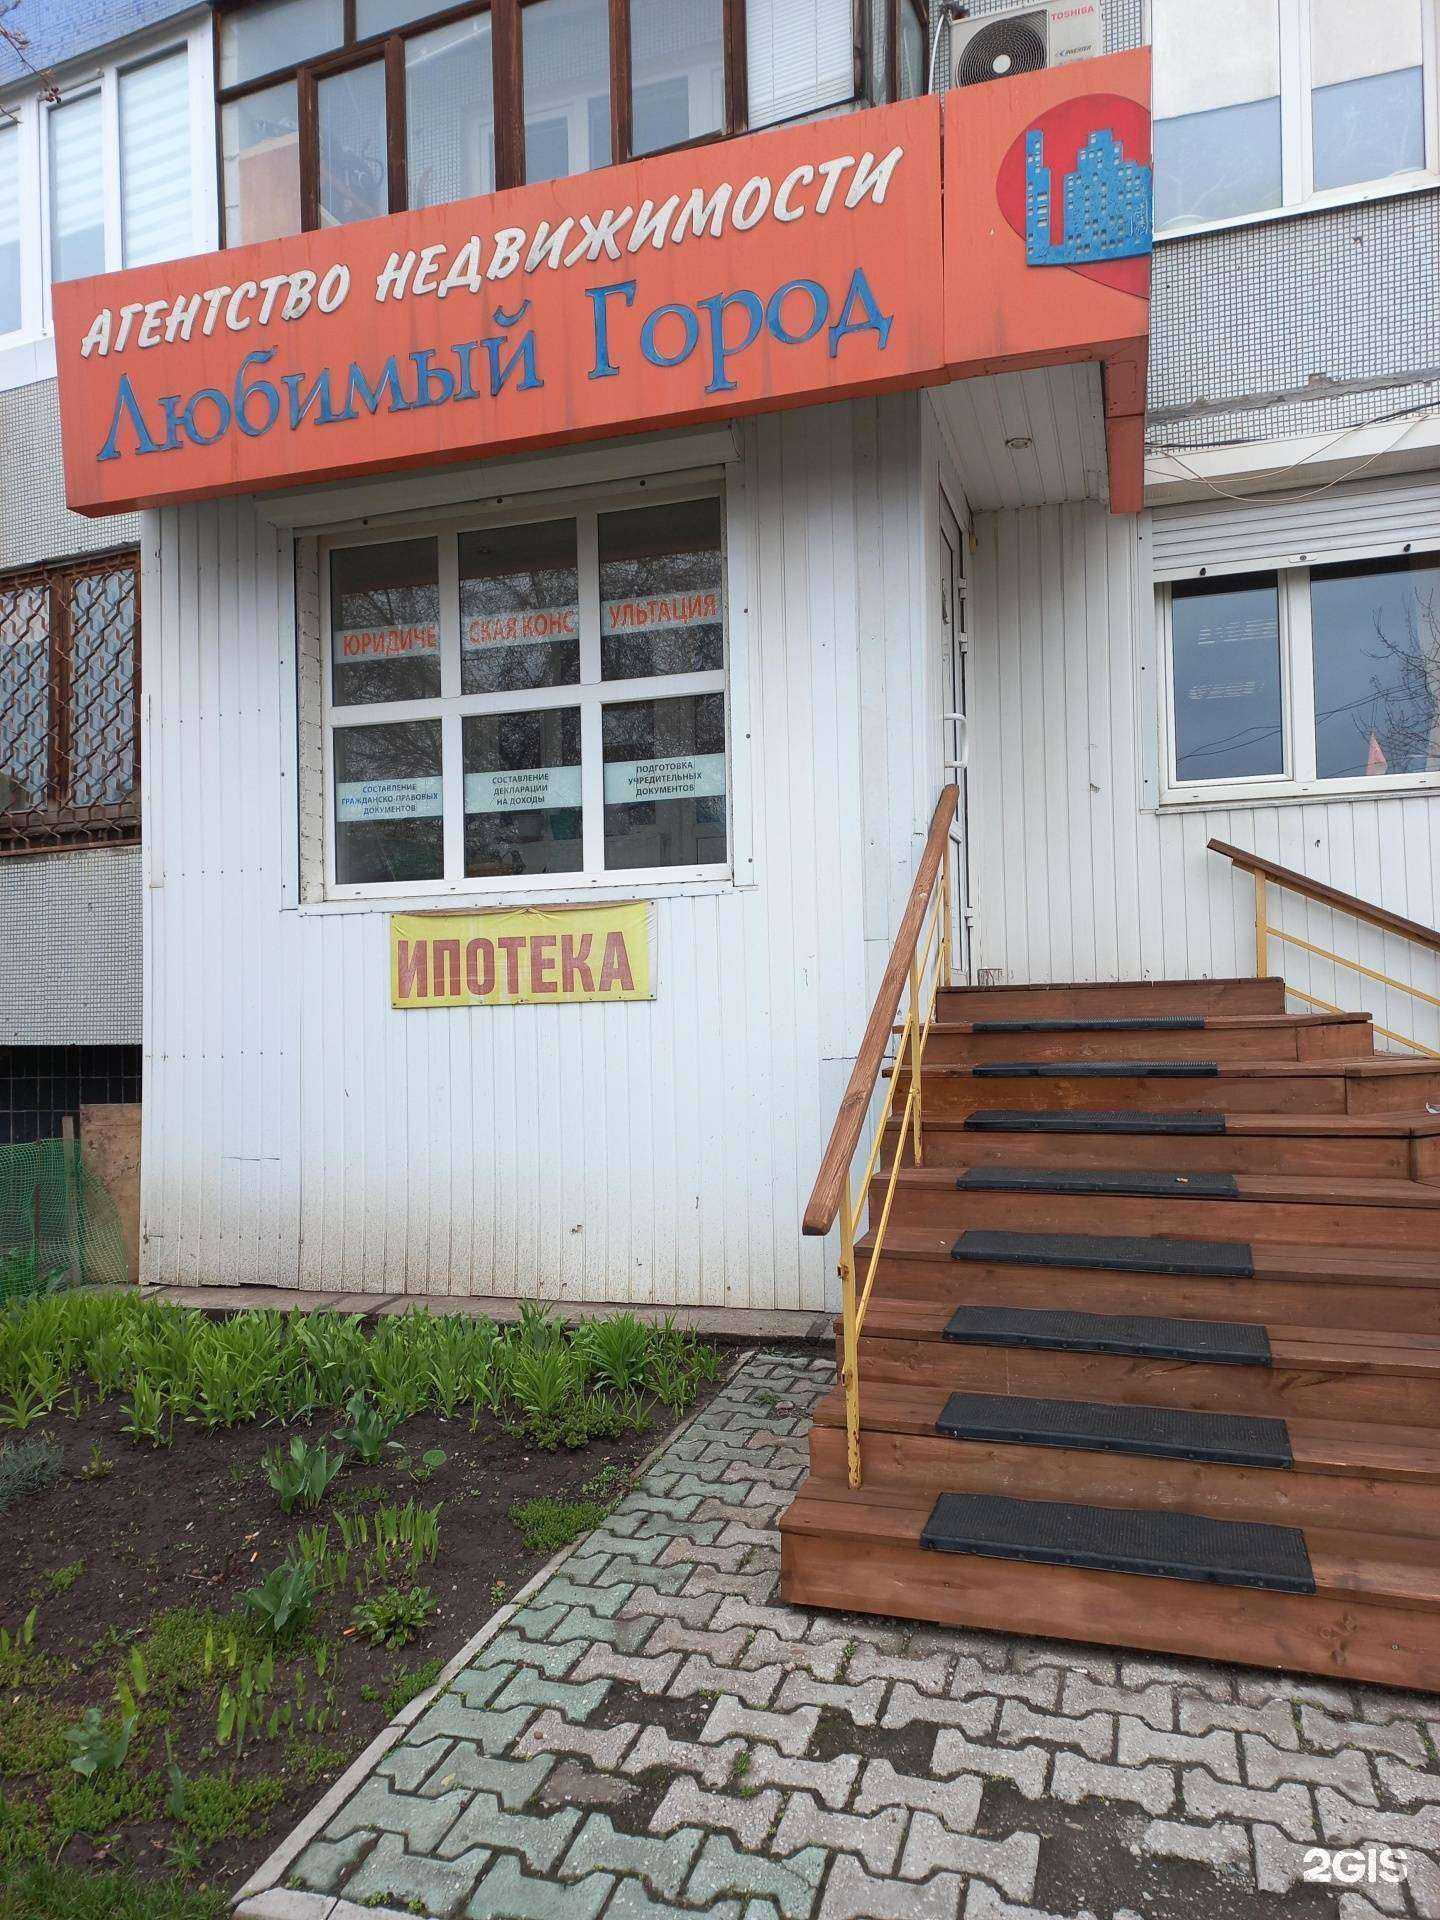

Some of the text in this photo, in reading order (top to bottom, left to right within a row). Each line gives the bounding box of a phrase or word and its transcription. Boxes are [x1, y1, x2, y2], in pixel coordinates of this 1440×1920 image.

[1051, 5, 1094, 21] TOSHIBA
[80, 146, 905, 358] АГЕНТСТВО НЕДВИЖИМОСТИ
[96, 267, 894, 462] Любимый Город
[343, 593, 717, 657] ЮРИДИЧЕ СКАЯ КОНС УЛЬТАЦИЯ
[636, 761, 693, 773] ПОДГОТОВКА
[492, 773, 549, 784] СОСТАВЛЕНИЕ
[628, 772, 702, 785] УЧРЕДИТЕЛЬНЫХ
[362, 783, 417, 794] СОСТАВЛЕНИЕ
[493, 784, 548, 796] ДЕКЛАРАЦИИ
[636, 784, 694, 796] ДОКУМЕНТОВ
[510, 796, 545, 806] ДОХОДЫ
[363, 804, 416, 816] ДОКУМЕНТОВ
[397, 931, 635, 998] ИПОТЕКА
